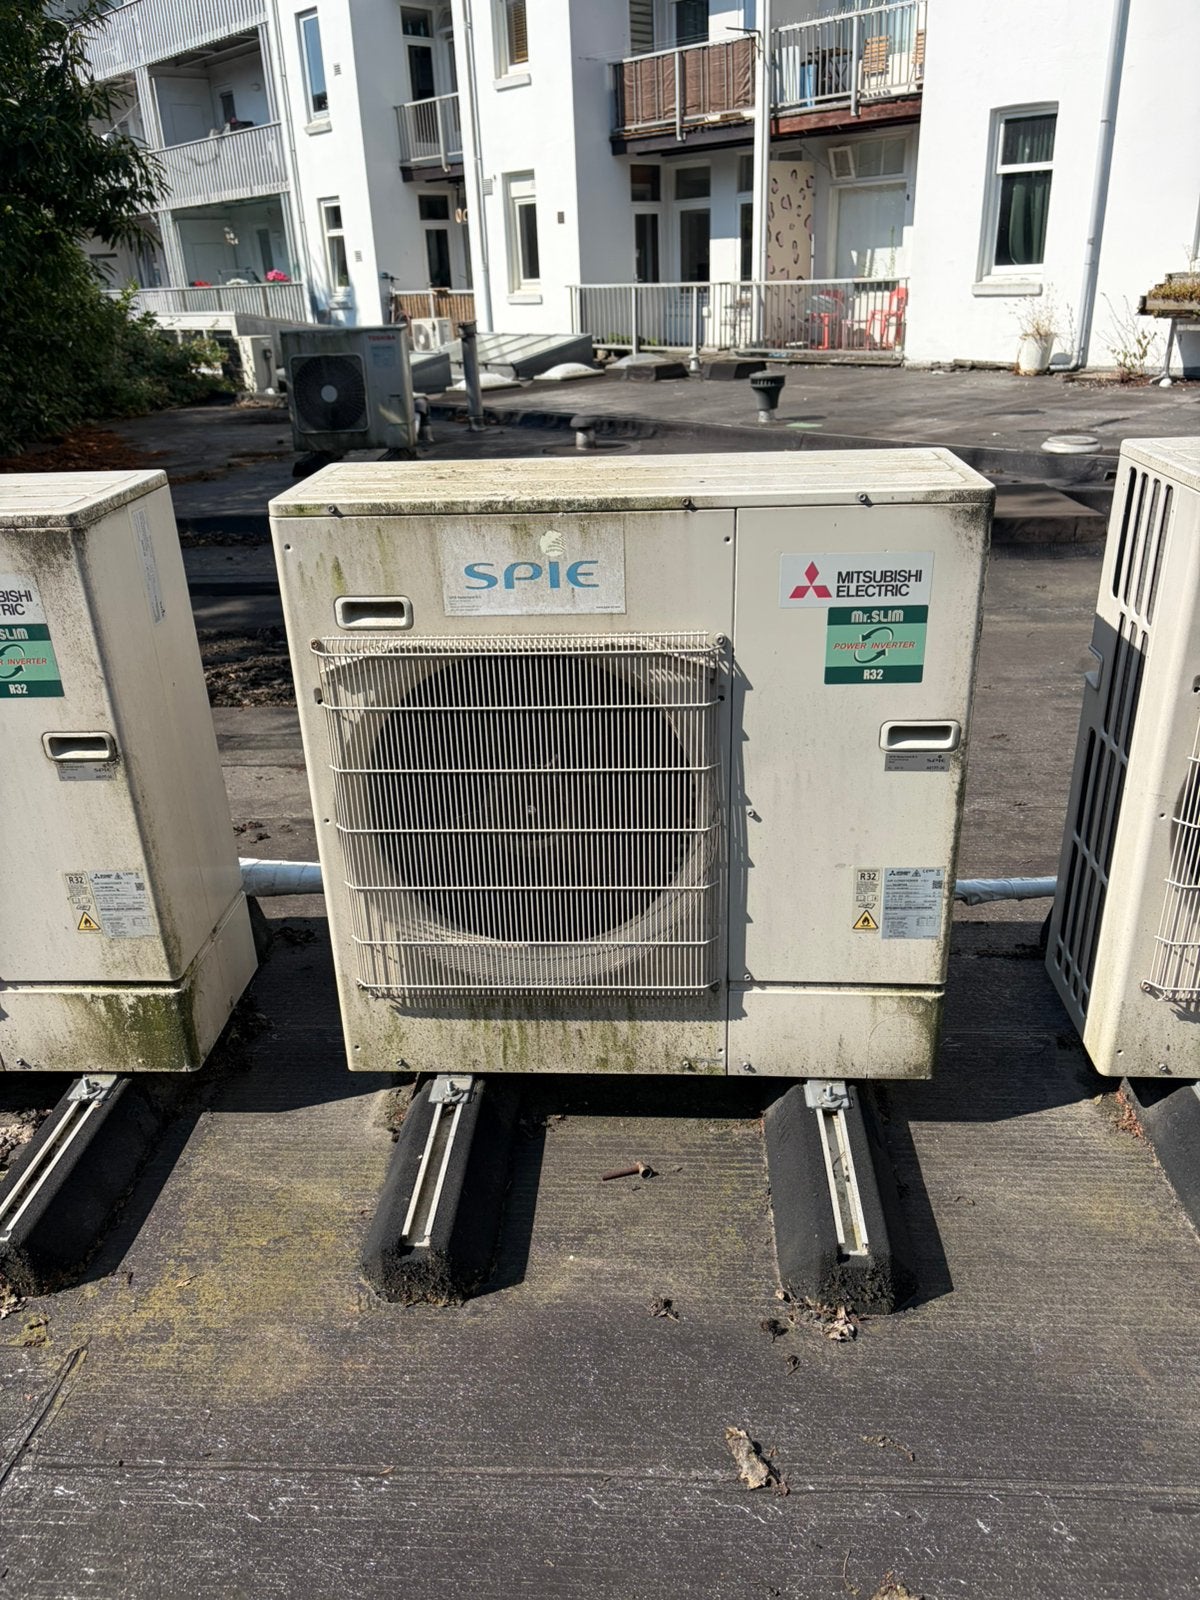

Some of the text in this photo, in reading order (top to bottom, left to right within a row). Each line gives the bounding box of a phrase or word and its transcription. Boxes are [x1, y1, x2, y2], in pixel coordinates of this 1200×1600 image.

[463, 560, 600, 590] SPIE
[837, 569, 923, 584] MITSUBISHI
[836, 584, 910, 598] ELECTRIC
[833, 641, 916, 650] POWER INVERTER
[863, 669, 884, 680] R32
[8, 684, 28, 694] R32
[68, 876, 84, 884] R32
[860, 872, 877, 881] R32
